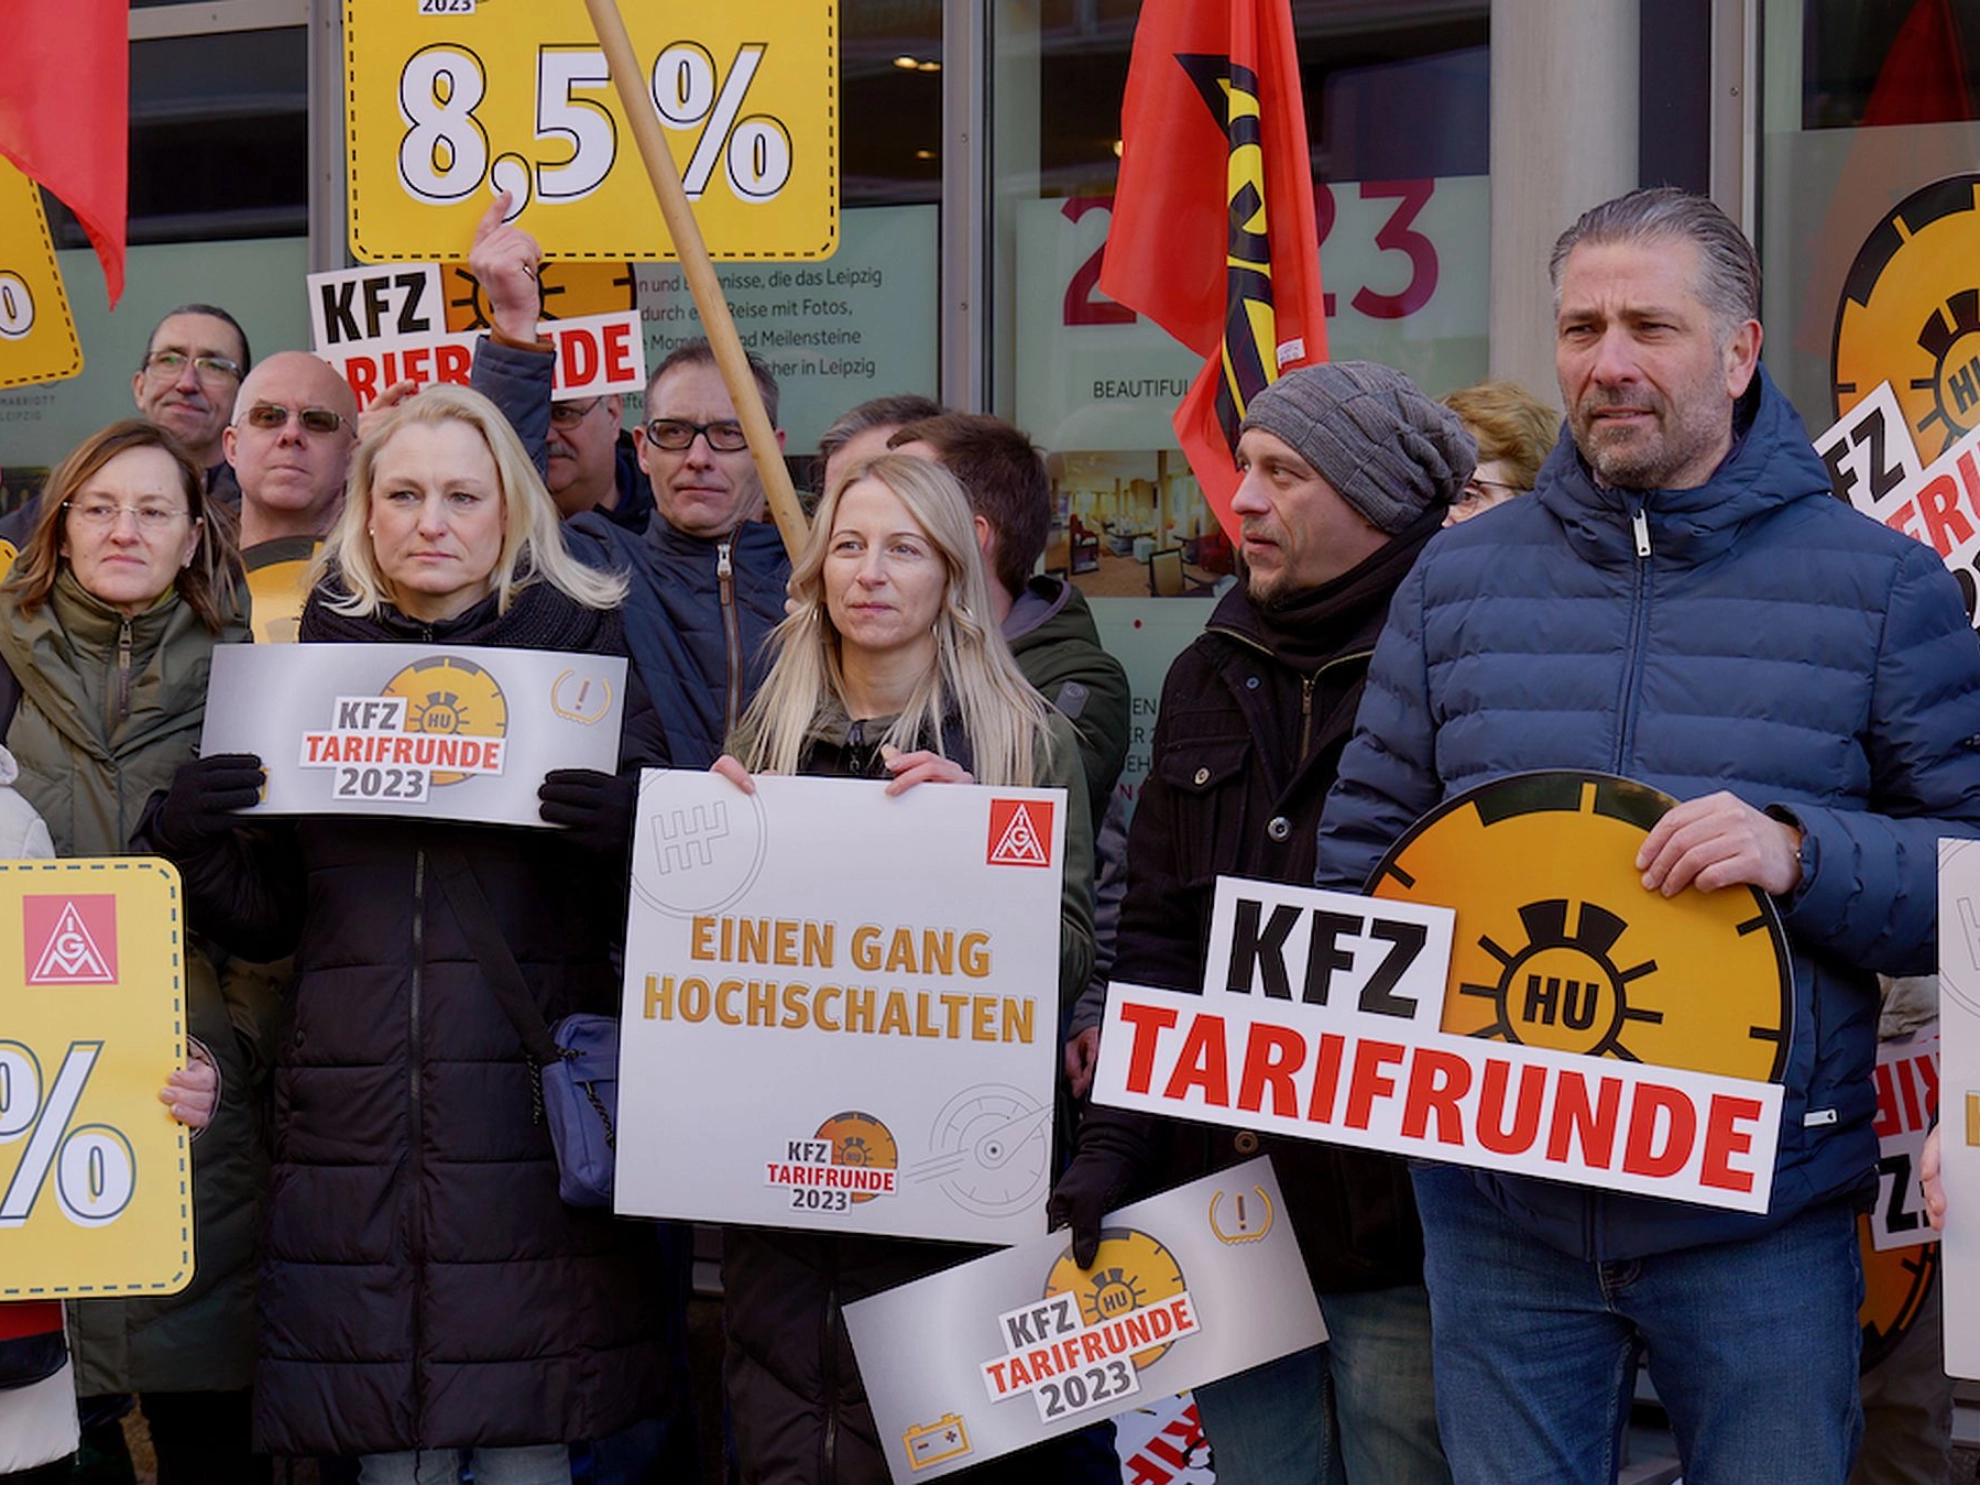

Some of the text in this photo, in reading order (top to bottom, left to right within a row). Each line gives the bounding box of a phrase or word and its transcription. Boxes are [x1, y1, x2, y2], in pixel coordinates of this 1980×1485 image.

[652, 275, 680, 293] und
[768, 269, 792, 289] die
[795, 269, 823, 287] das
[826, 267, 883, 289] Leipzig
[321, 271, 430, 344] KFZ
[640, 304, 686, 322] durch
[772, 299, 798, 317] mit
[802, 298, 853, 317] Fotos,
[761, 328, 862, 348] Meilensteine
[801, 358, 816, 376] in
[820, 358, 876, 379] Leipzig
[1820, 406, 1906, 506] FZ
[338, 701, 400, 731] KFZ
[428, 712, 452, 730] HU
[306, 735, 501, 770] TARIFRUNDE
[338, 767, 424, 798] 2023
[690, 915, 992, 978] EINEN GANG
[1226, 898, 1428, 1020] KFZ
[642, 972, 1039, 1045] HOCHSCHALTEN
[1523, 974, 1599, 1031] HU
[1120, 1002, 1764, 1194] TARIFRUNDE
[788, 1141, 828, 1164] KFZ
[766, 1162, 895, 1192] TARIFRUNDE
[792, 1188, 848, 1212] 2023
[1102, 1290, 1128, 1313] HU
[1006, 1299, 1076, 1349] KFZ
[985, 1298, 1194, 1395] TARIFRUNDE
[1039, 1360, 1132, 1418] 2023
